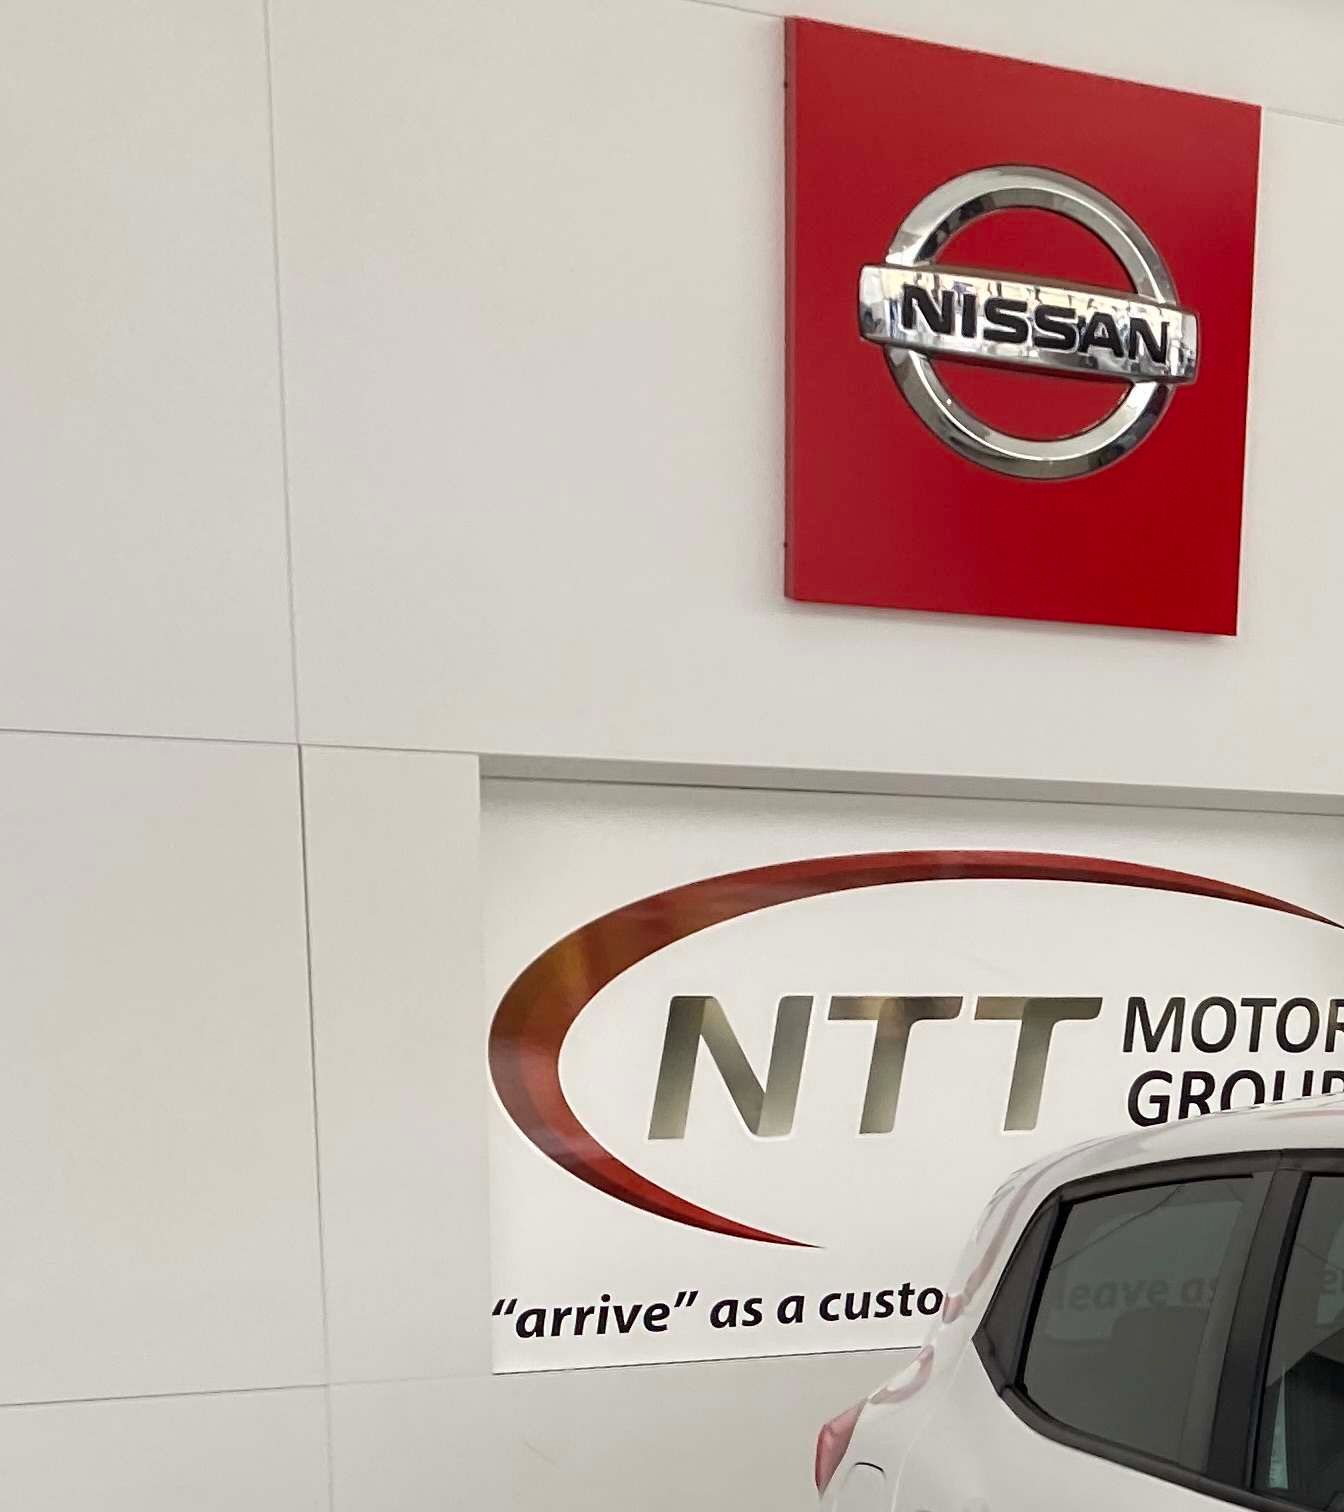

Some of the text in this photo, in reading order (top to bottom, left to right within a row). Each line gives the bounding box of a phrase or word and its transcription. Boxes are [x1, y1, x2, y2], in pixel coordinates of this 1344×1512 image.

[901, 284, 1171, 365] NISSAN
[647, 993, 1104, 1142] NTT
[491, 1280, 945, 1339] “arrive” as a custo
